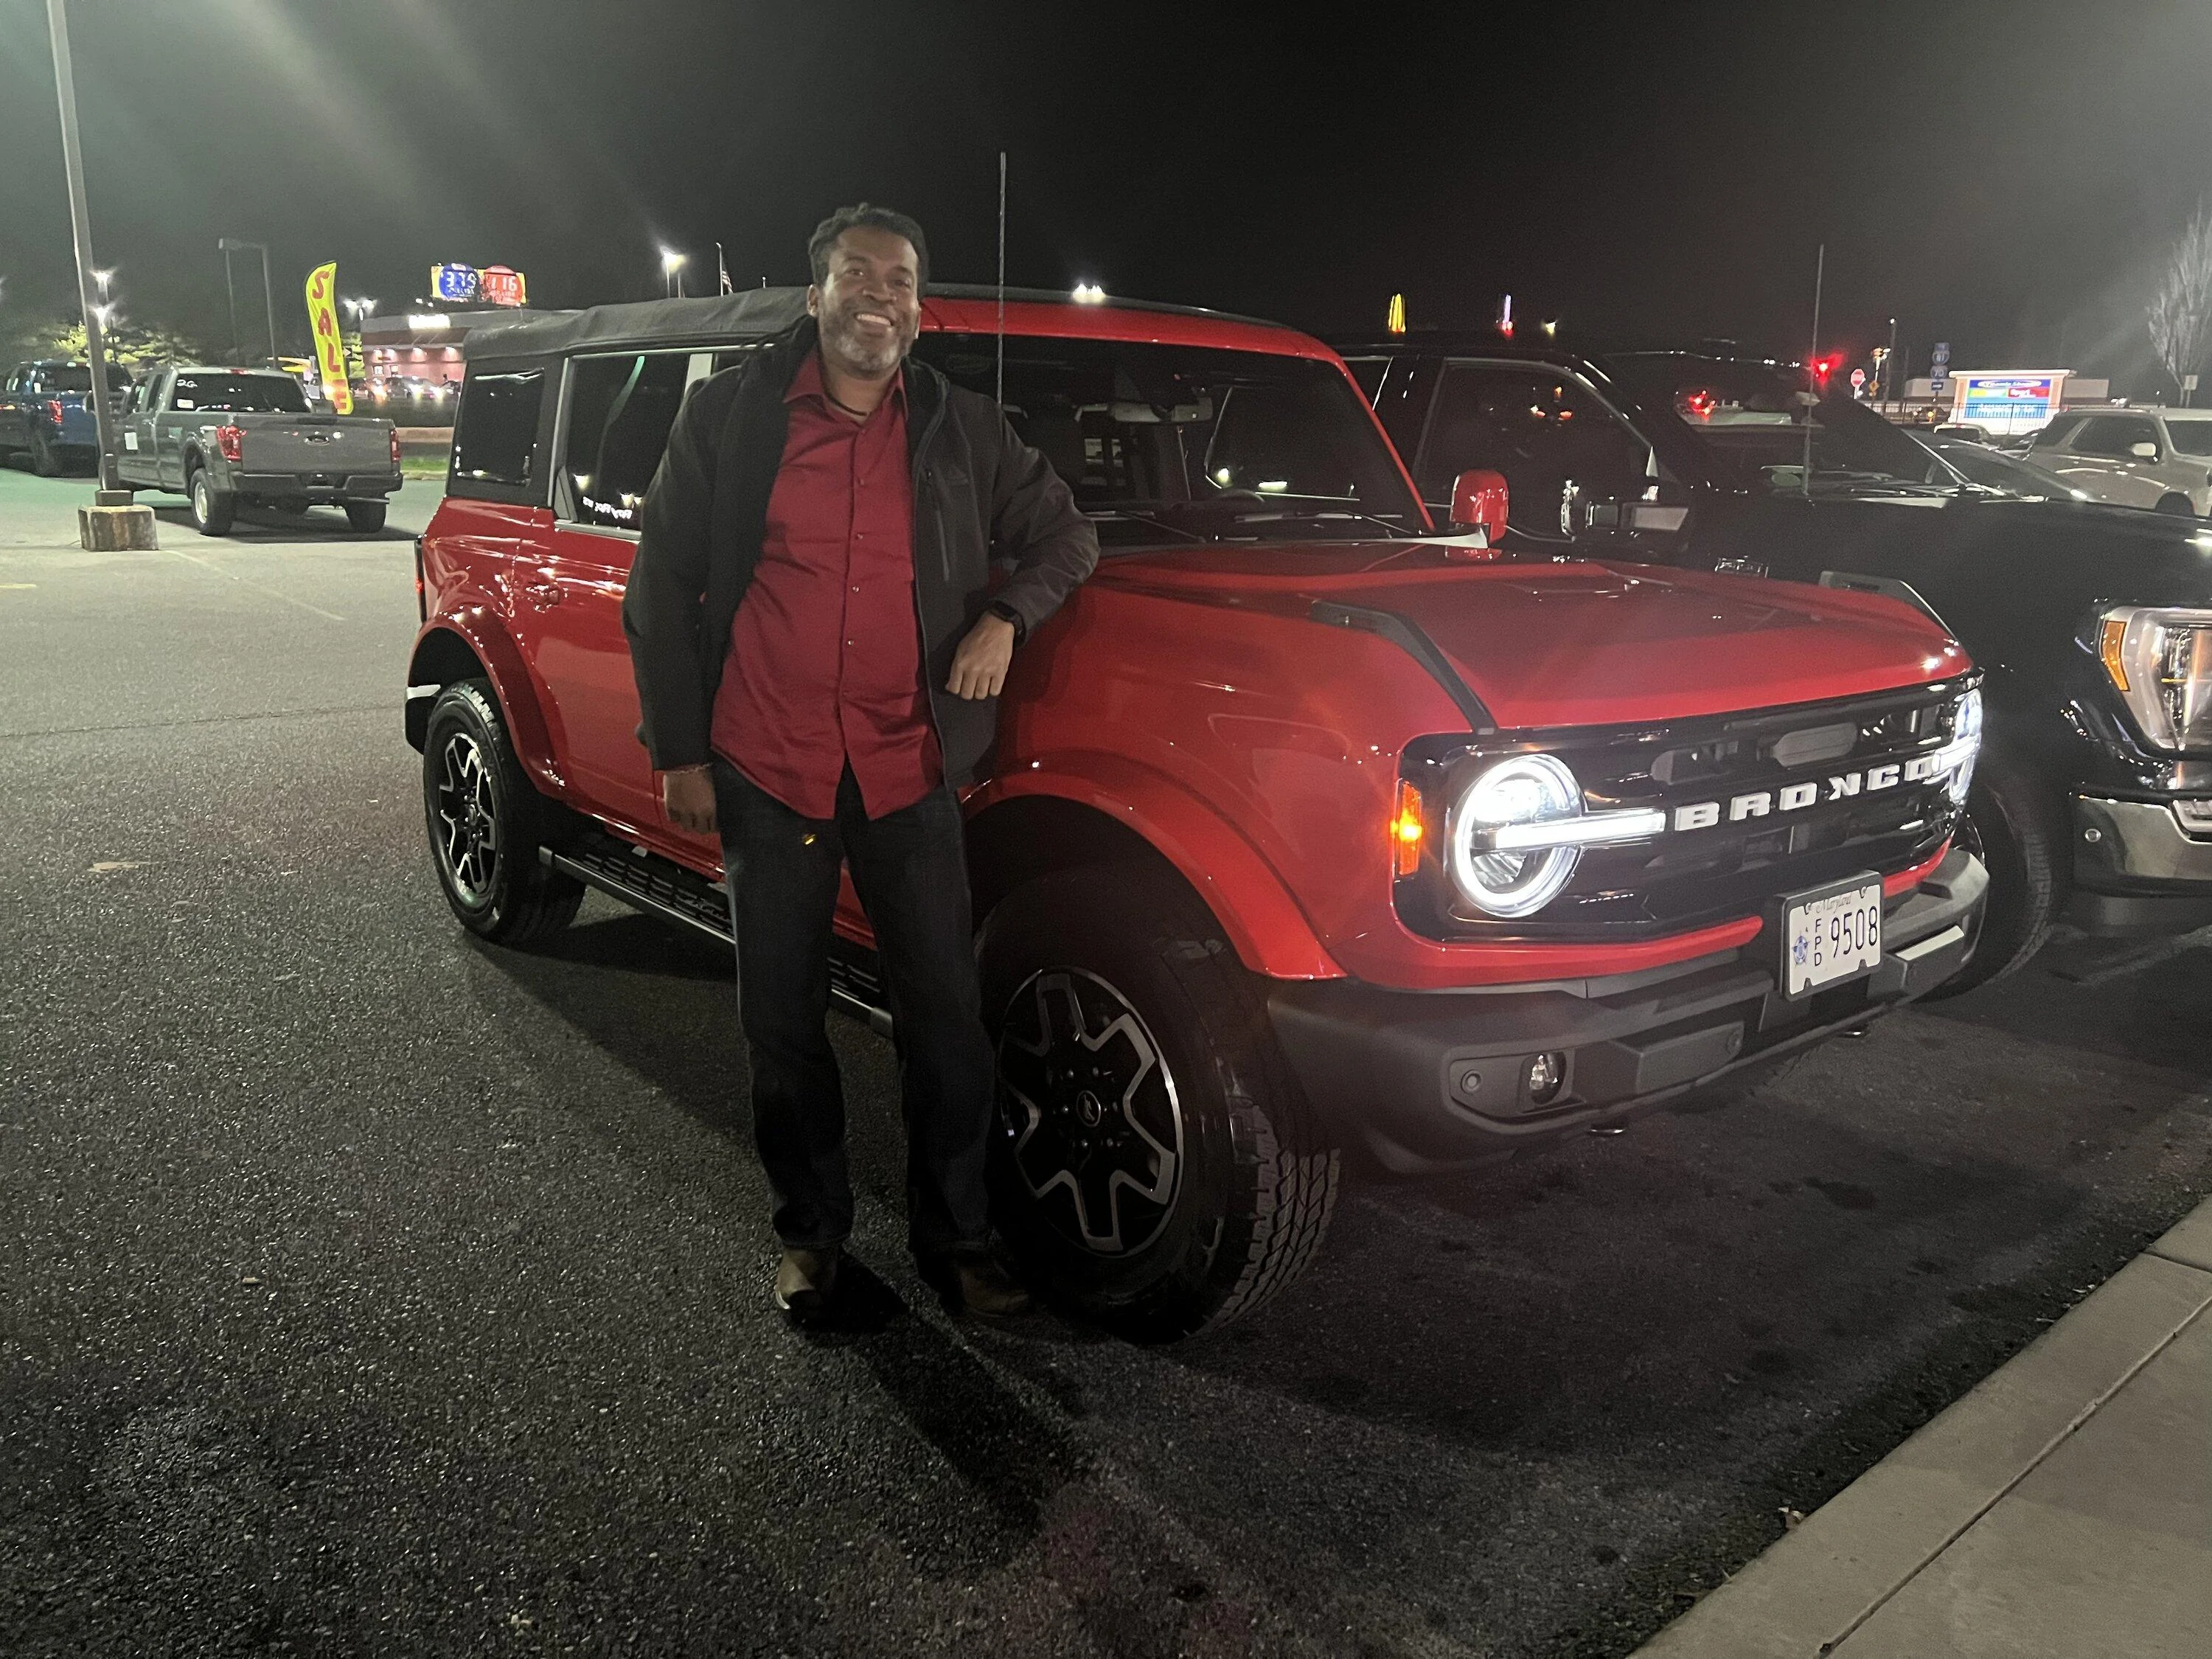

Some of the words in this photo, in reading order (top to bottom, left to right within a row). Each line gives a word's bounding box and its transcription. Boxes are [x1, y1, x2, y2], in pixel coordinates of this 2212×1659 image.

[312, 270, 347, 410] SALE
[1674, 756, 1936, 832] BRONCO
[1831, 905, 1877, 959] 9508
